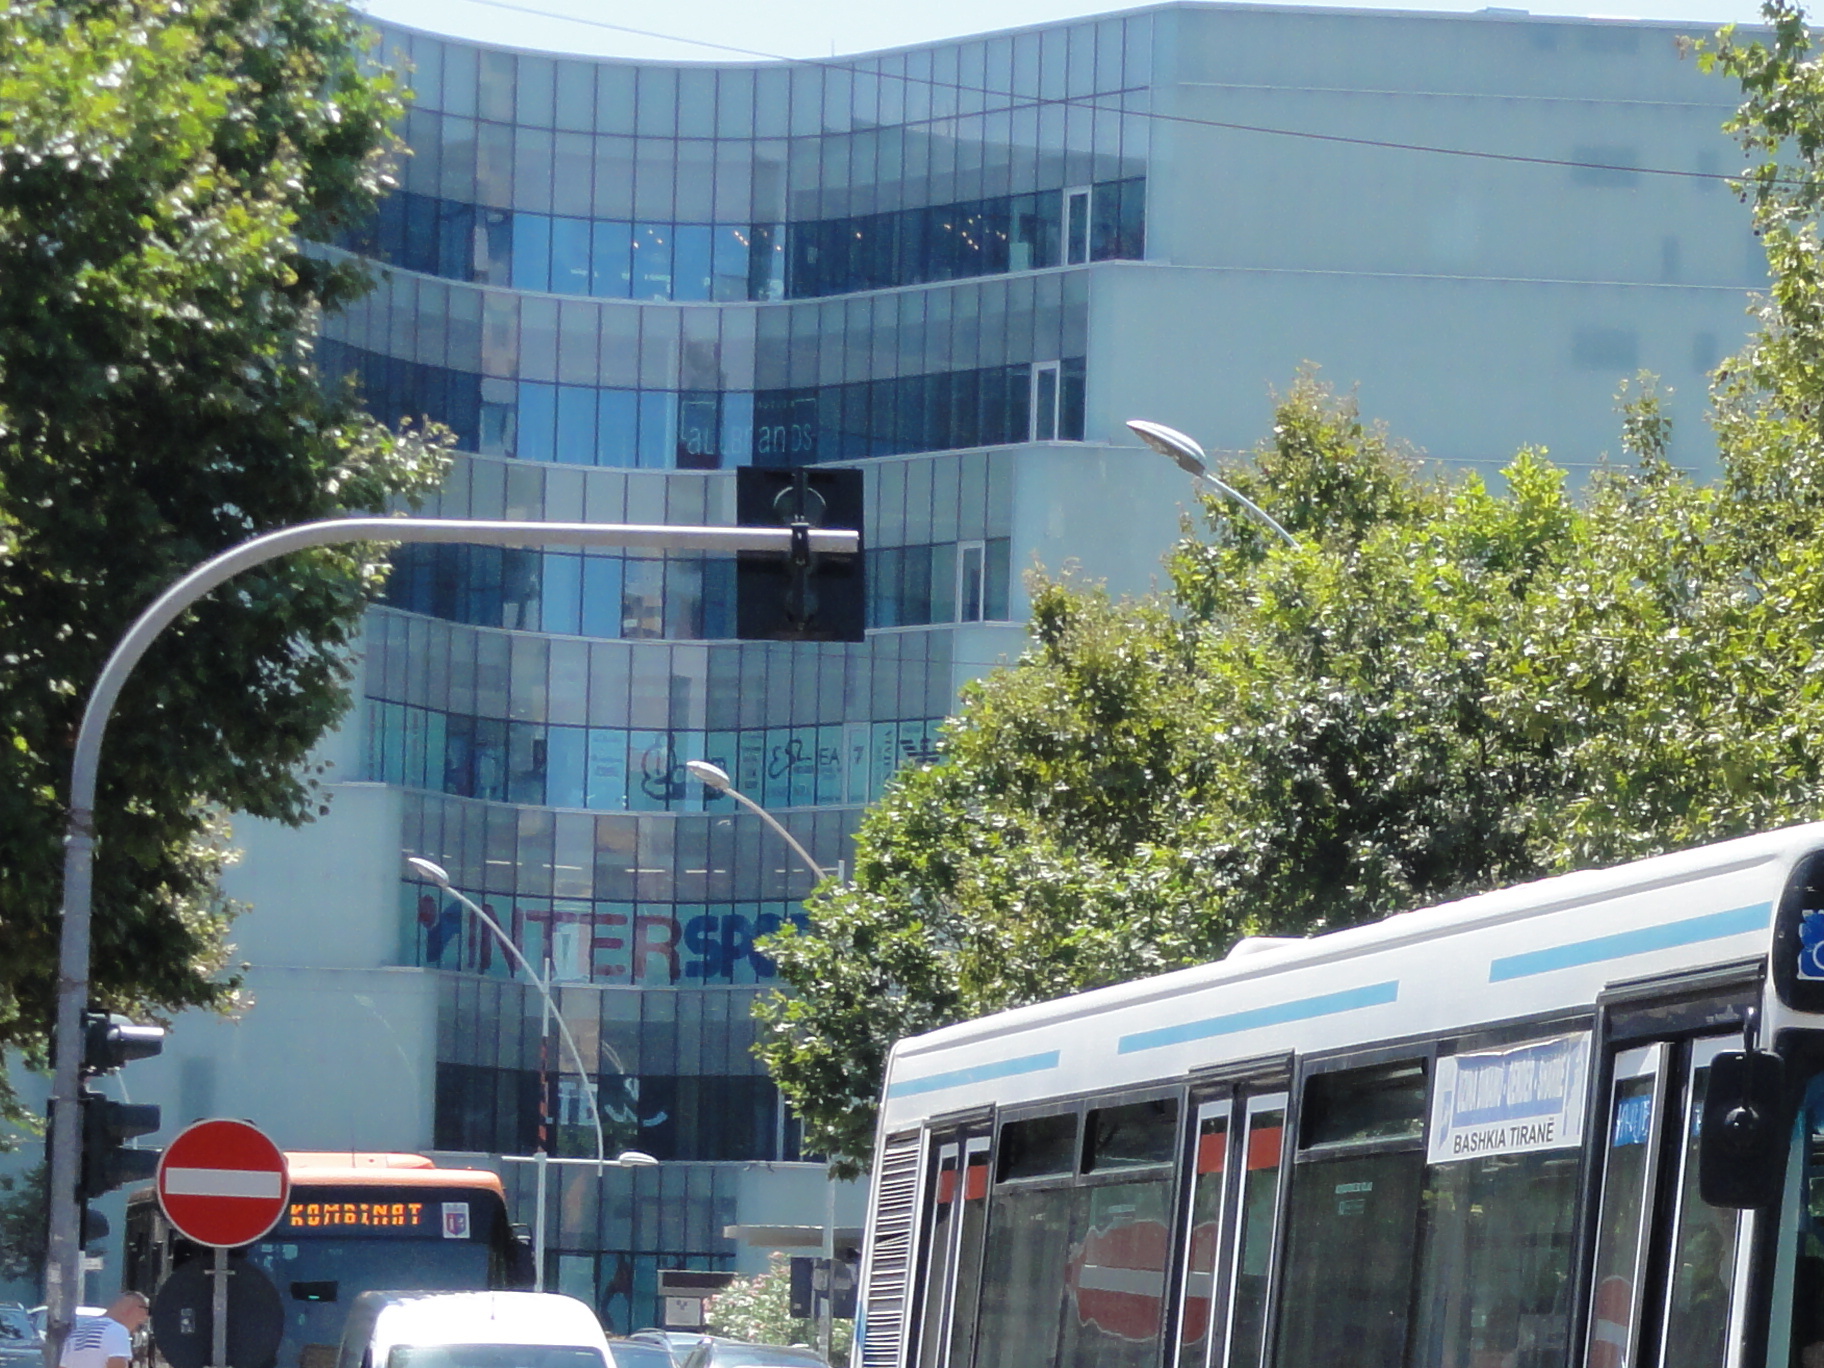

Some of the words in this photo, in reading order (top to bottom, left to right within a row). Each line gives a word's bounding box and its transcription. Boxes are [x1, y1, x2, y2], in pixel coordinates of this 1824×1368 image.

[1453, 1129, 1507, 1155] BASHKIA
[1509, 1117, 1556, 1145] TIRANË
[289, 1202, 423, 1227] KOMBINAT
